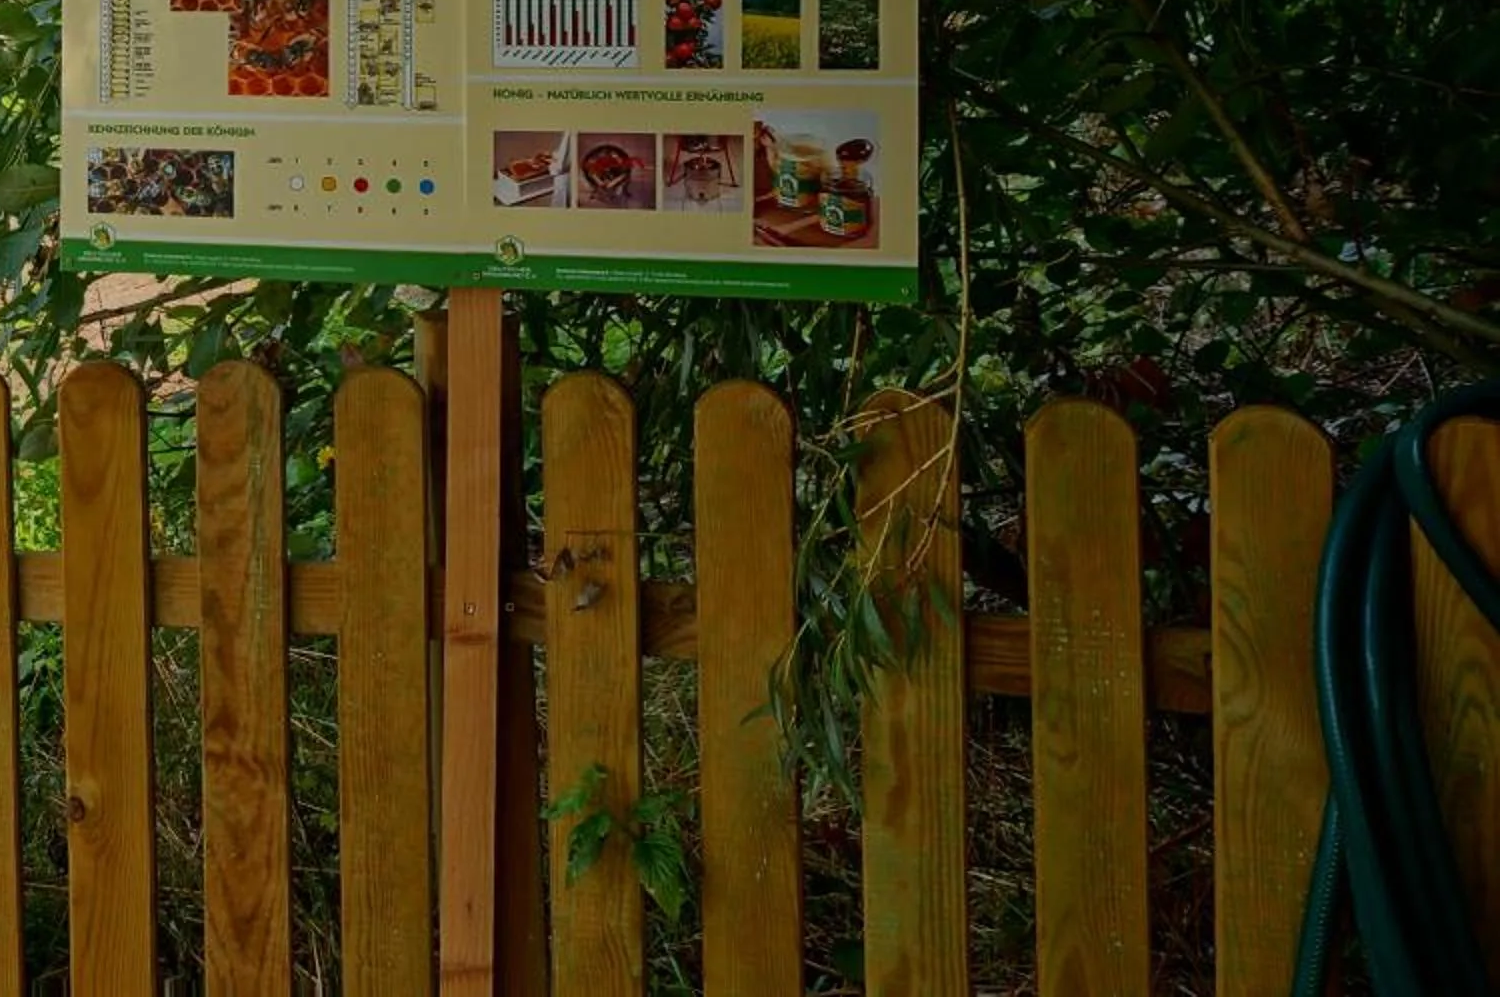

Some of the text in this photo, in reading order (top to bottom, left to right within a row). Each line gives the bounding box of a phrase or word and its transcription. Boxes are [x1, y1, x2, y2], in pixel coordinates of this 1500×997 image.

[493, 88, 533, 100] HONIG
[547, 88, 613, 100] NATÜRLICH
[615, 90, 682, 101] WERTVOLLE
[686, 89, 764, 102] ERNÄHRUNG
